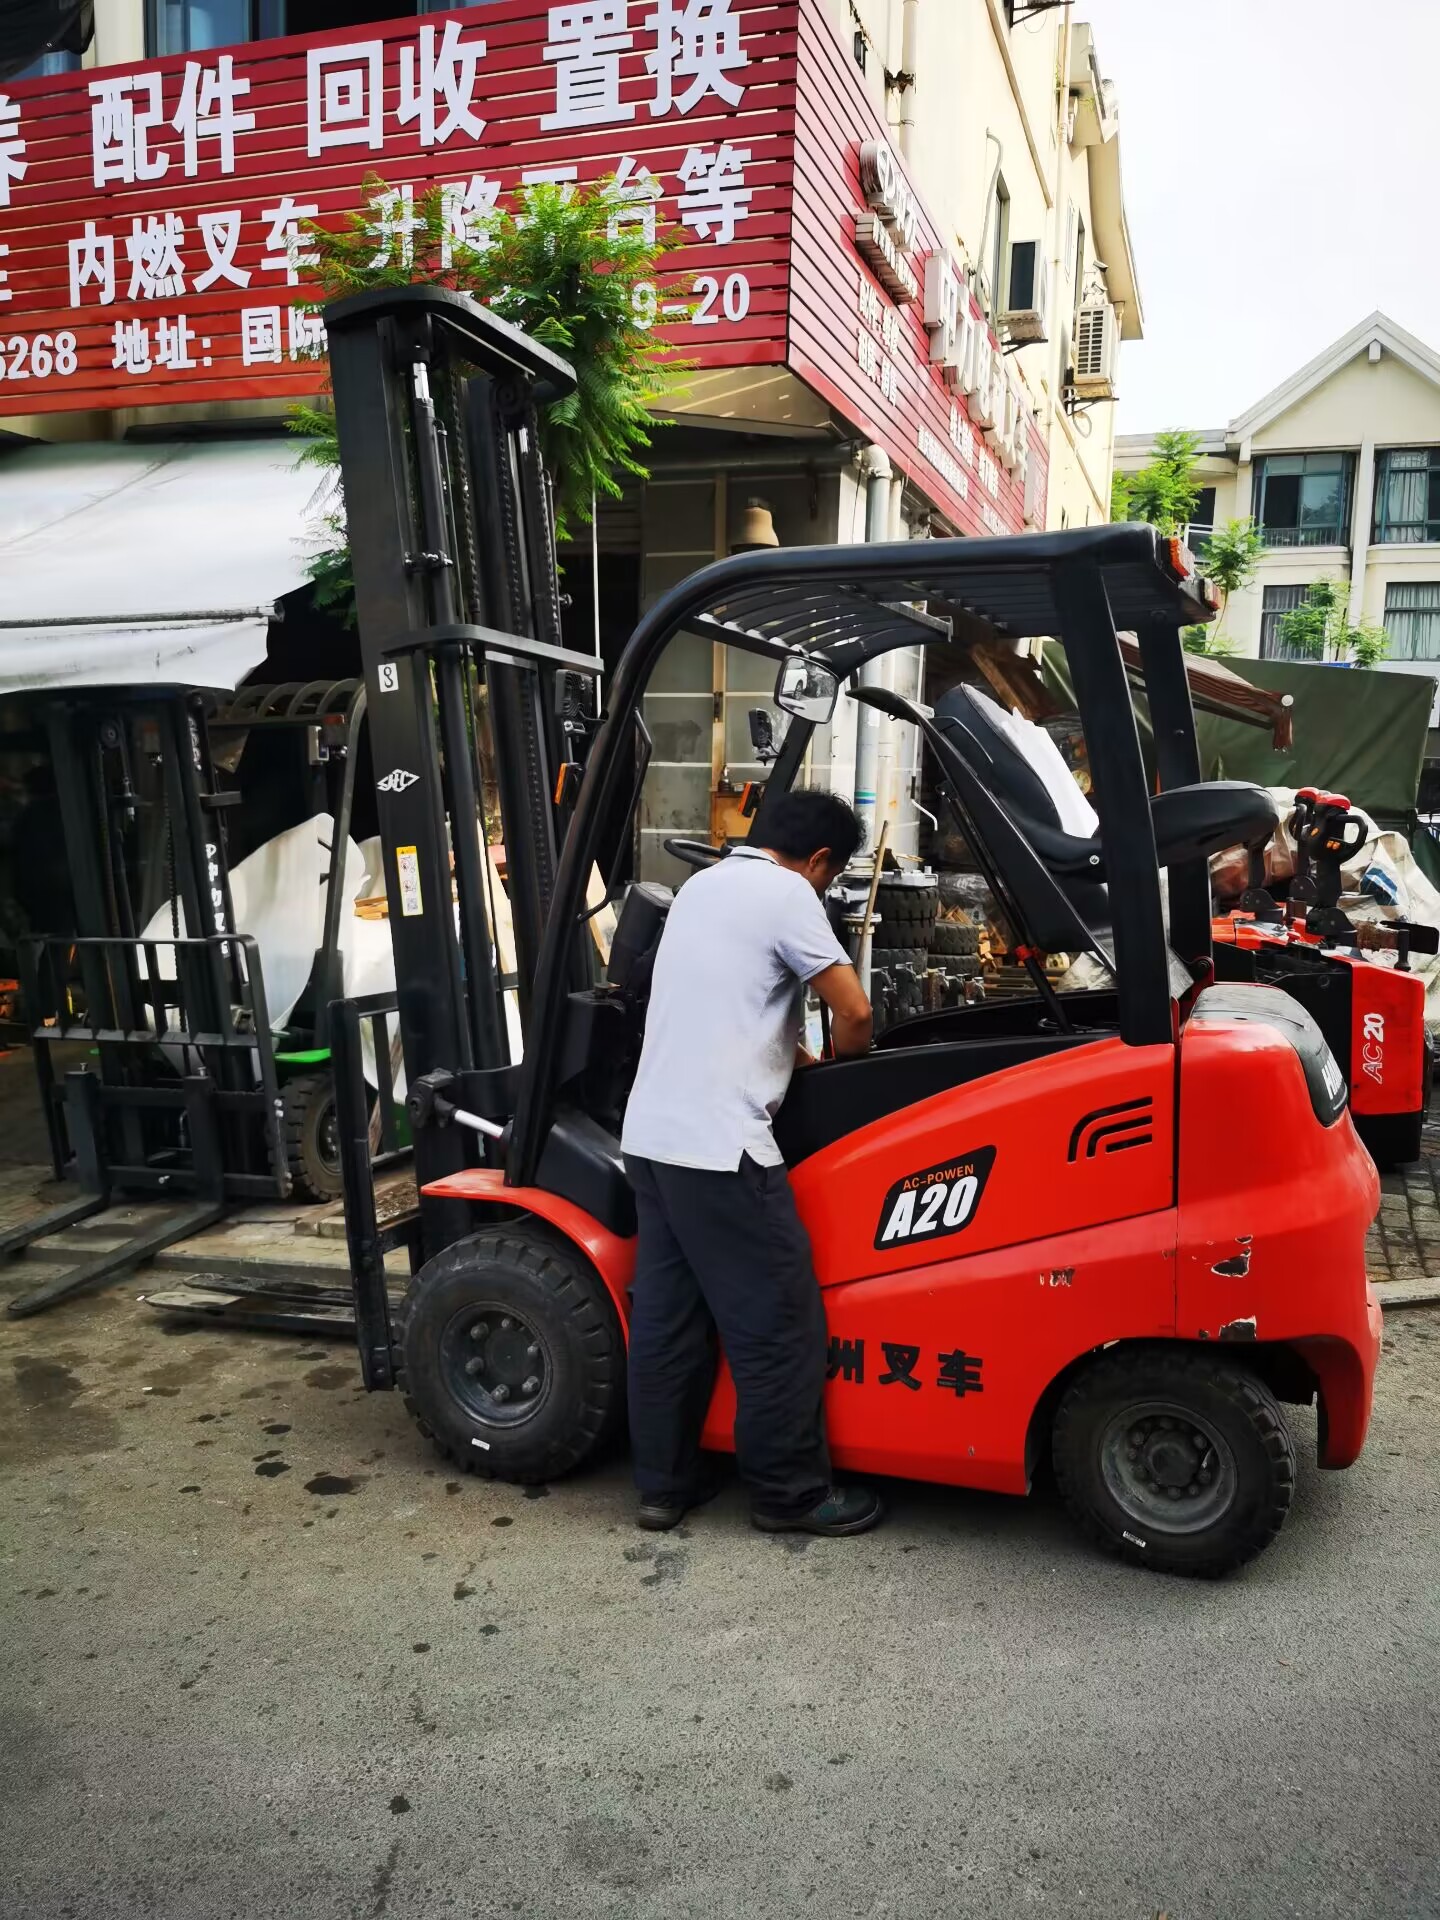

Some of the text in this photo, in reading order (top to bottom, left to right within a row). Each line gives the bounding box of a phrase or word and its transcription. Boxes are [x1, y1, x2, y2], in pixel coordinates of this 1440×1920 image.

[88, 55, 255, 188] 配件
[307, 19, 488, 158] 回收
[540, 0, 748, 131] 置换
[68, 198, 320, 308] 内燃叉车
[0, 331, 77, 381] 268
[881, 1175, 979, 1242] A20
[902, 1163, 975, 1191] AC-POWEN
